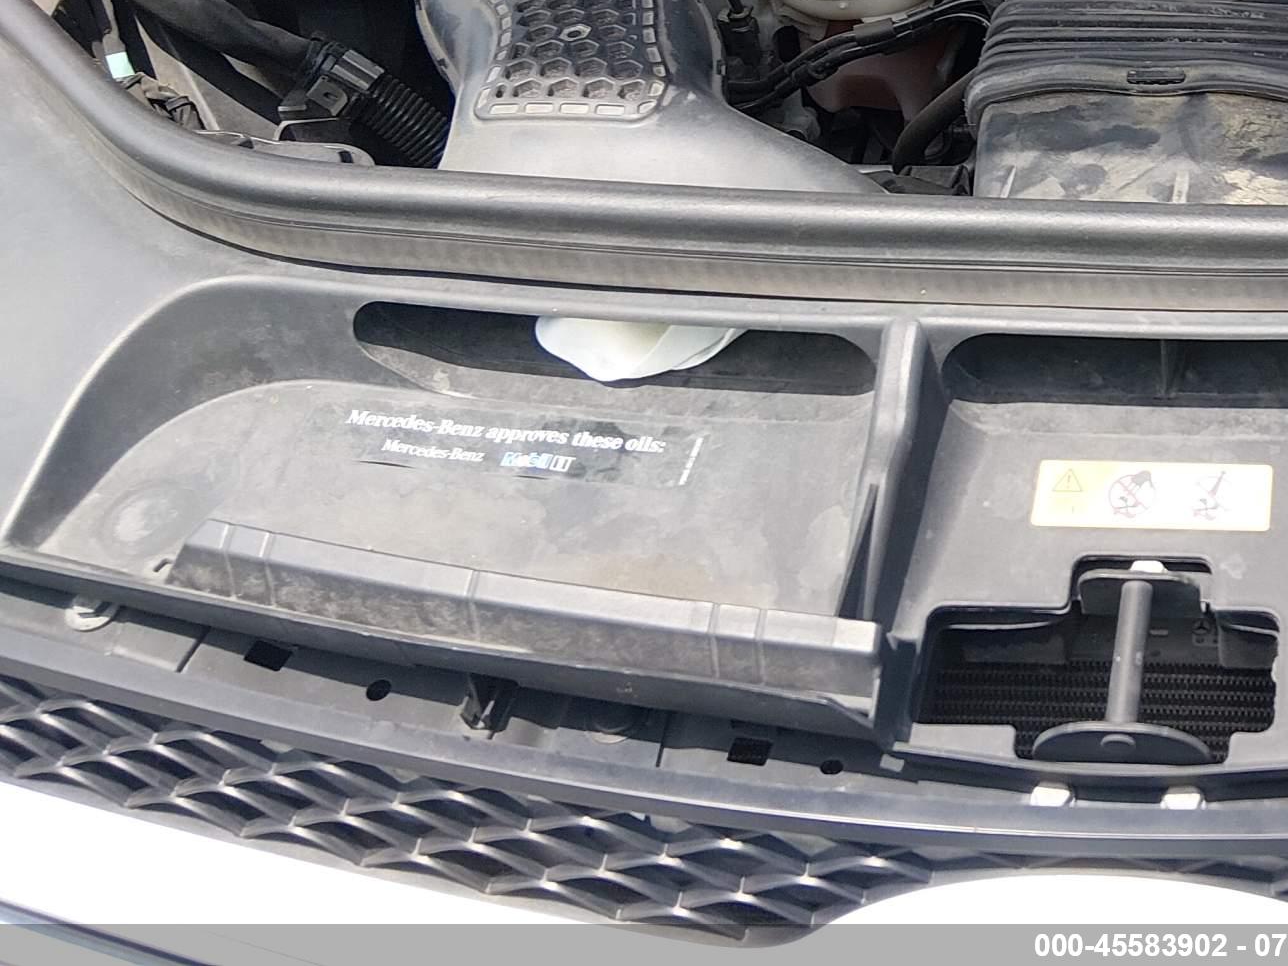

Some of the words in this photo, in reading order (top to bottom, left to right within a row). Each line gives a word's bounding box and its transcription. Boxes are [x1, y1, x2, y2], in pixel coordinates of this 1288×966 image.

[345, 410, 484, 440] Mercedes-Benz
[484, 427, 569, 446] approves
[571, 431, 623, 451] these
[624, 438, 666, 454] oils:
[381, 439, 484, 462] Mercedes-Benz
